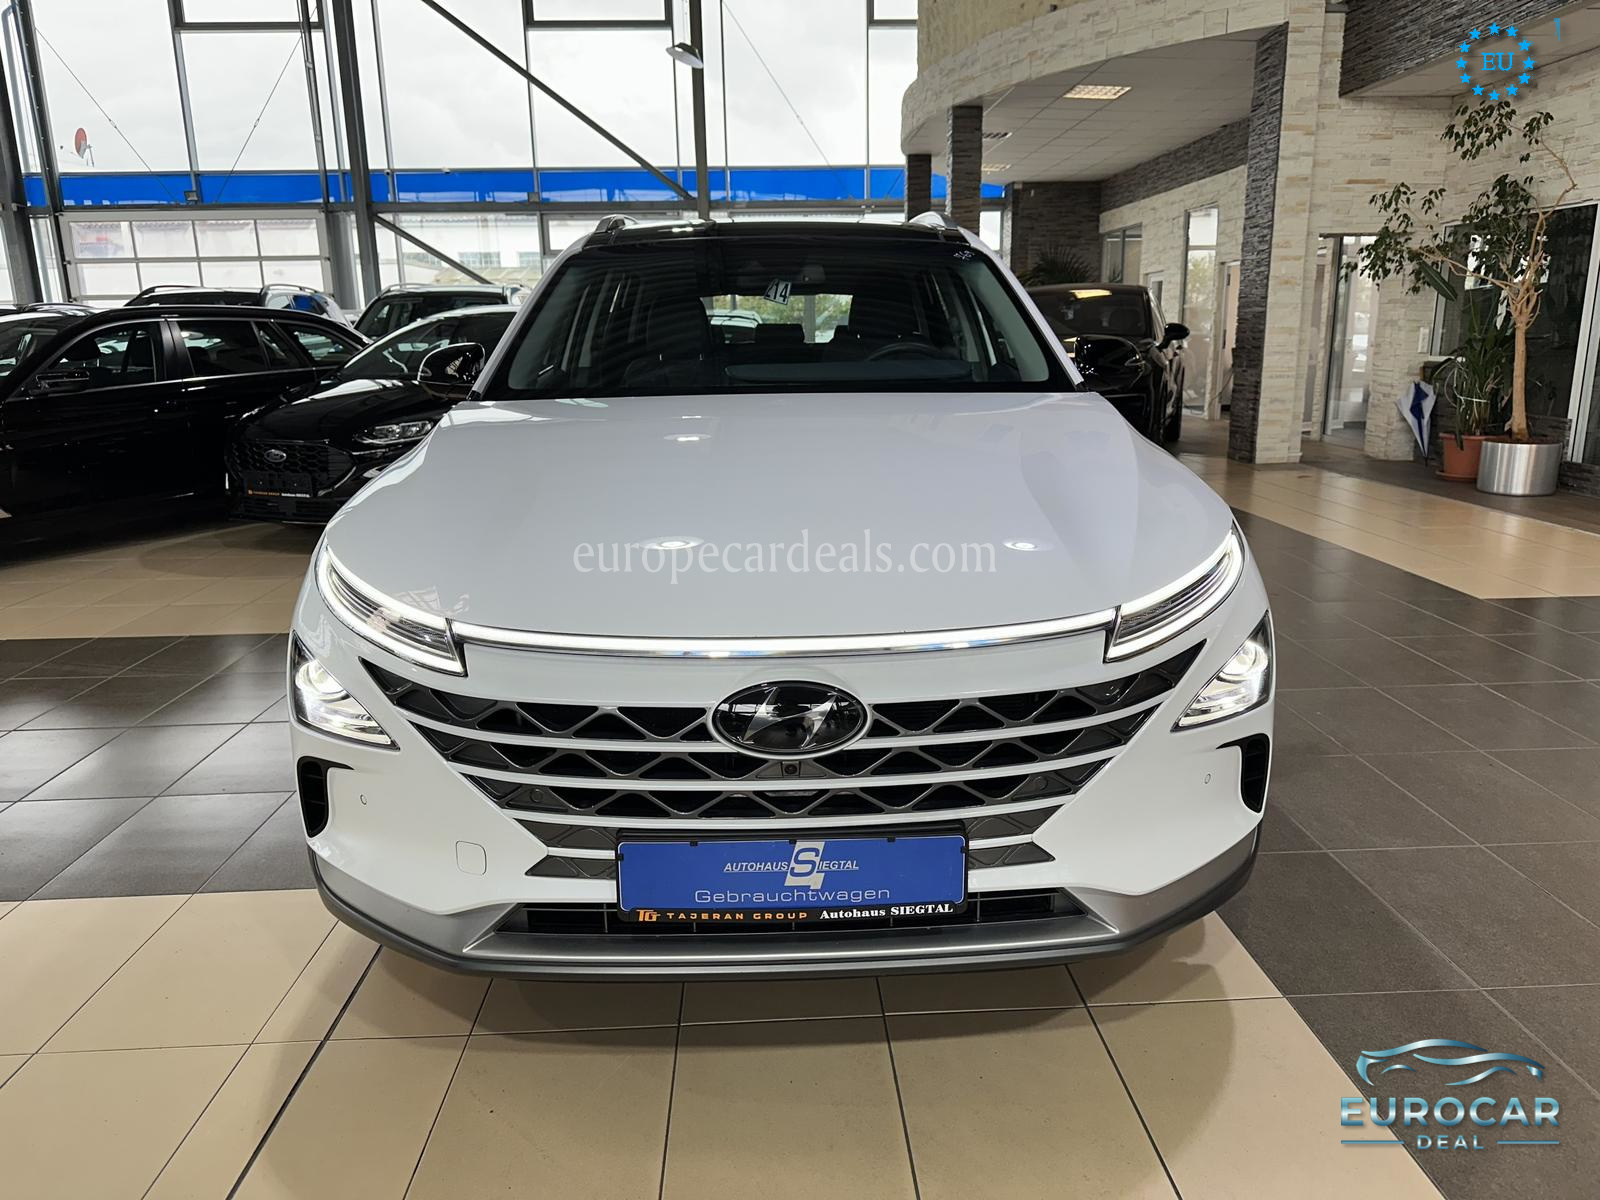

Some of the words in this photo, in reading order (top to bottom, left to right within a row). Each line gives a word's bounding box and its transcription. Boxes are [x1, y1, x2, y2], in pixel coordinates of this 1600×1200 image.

[724, 861, 787, 873] AUTOHAUS
[694, 888, 890, 903] Gebrauchtwagen
[667, 911, 744, 920] TAJERAN
[753, 911, 808, 920] GROUP
[819, 908, 886, 919] Autohaus
[890, 904, 953, 916] SIEGTAL
